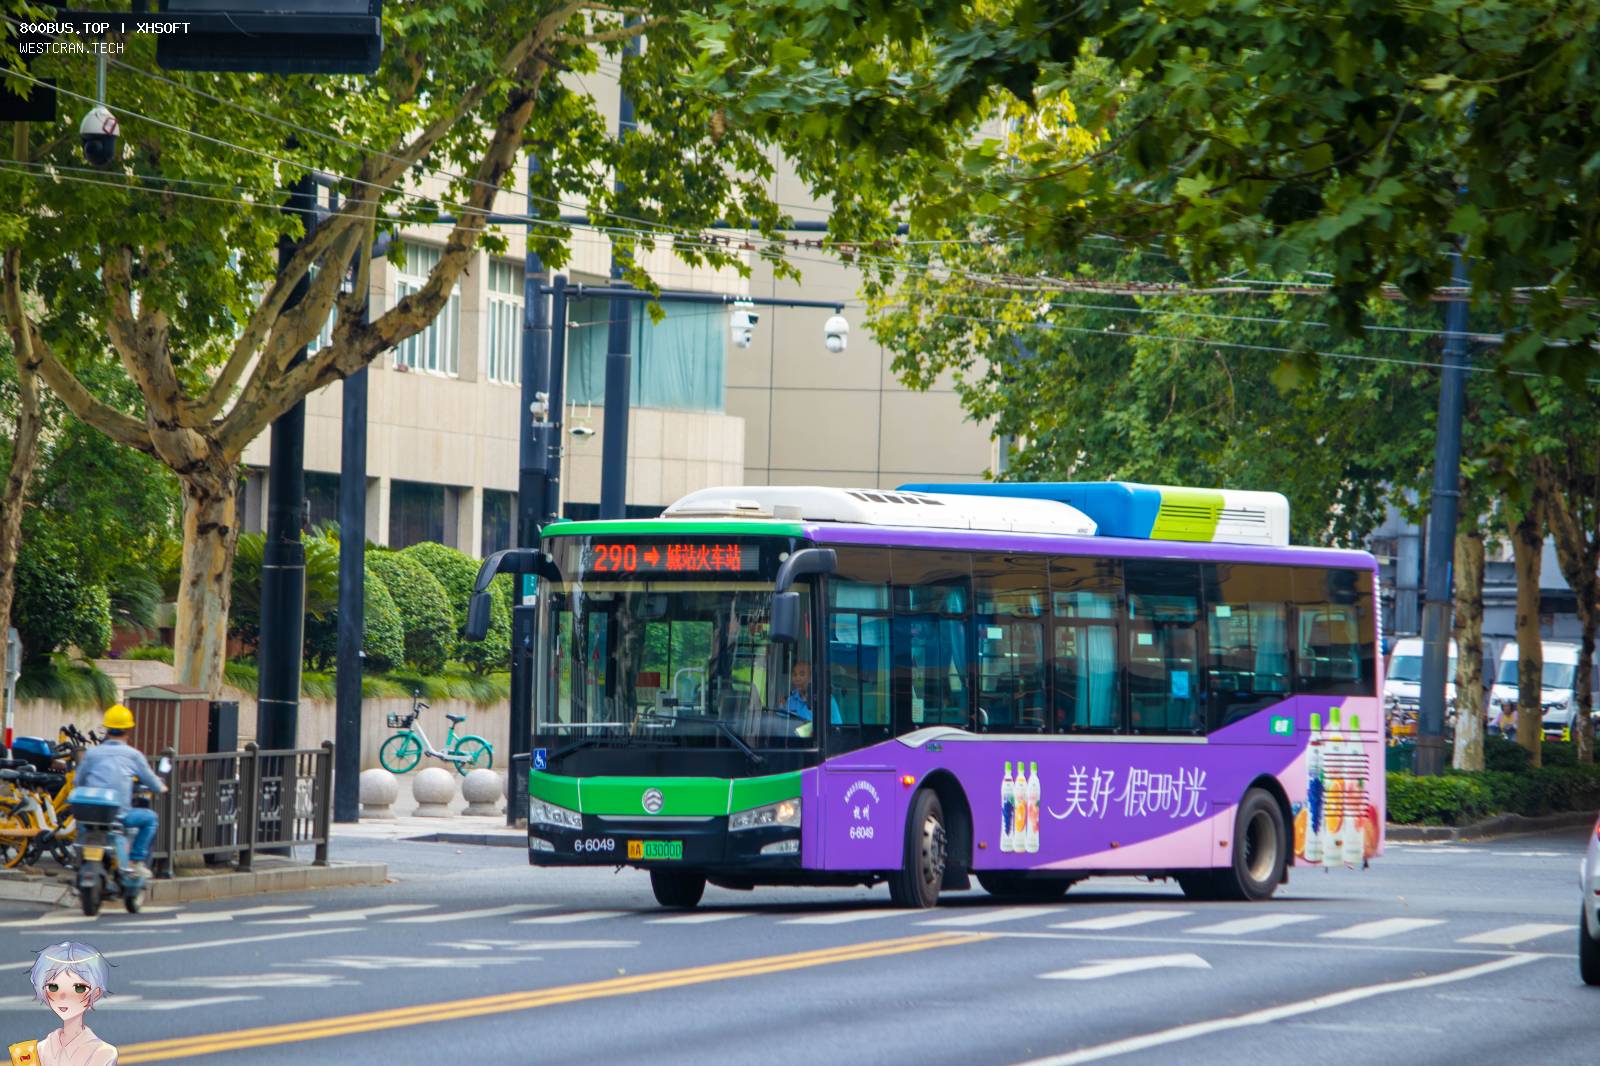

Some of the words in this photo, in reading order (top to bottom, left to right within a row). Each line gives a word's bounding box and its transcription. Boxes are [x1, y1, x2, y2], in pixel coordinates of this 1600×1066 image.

[594, 544, 637, 571] 290
[666, 543, 742, 571] 城站火车站
[849, 826, 874, 839] 6-6049
[574, 838, 615, 852] 6-6049
